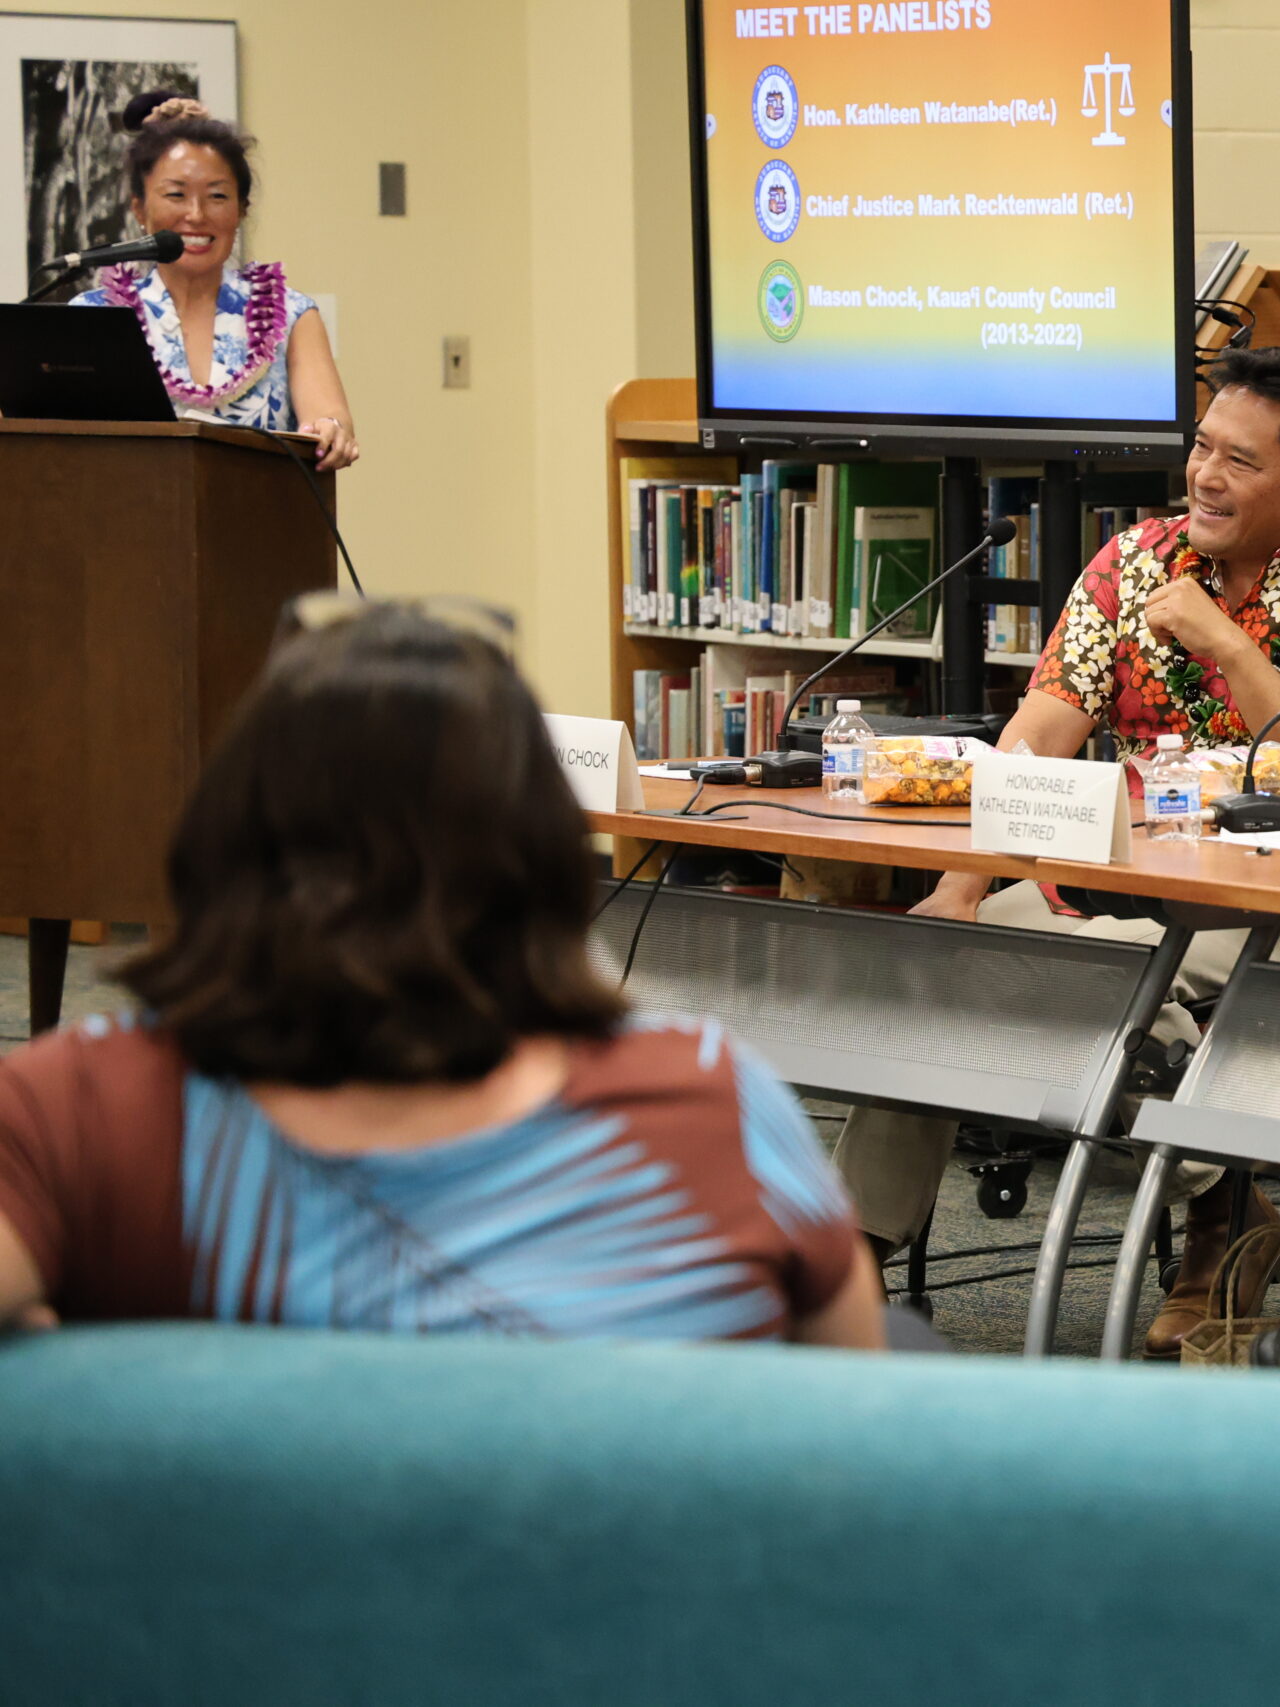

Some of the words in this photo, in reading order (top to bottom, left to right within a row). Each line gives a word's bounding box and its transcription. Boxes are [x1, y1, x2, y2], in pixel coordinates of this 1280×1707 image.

[736, 7, 798, 38] MEET
[804, 5, 852, 35] THE
[858, 0, 992, 33] PANELISTS
[803, 105, 841, 126] Hon.
[845, 103, 920, 126] Kathleen
[924, 98, 1057, 127] Watanabe(Ret.)
[806, 195, 849, 217] Chief
[853, 195, 914, 216] Justice
[918, 194, 961, 216] Mark
[965, 192, 1079, 216] Recktenwald
[1085, 191, 1134, 220] (Ret.)
[808, 285, 862, 307] Mason
[866, 285, 923, 312] Chock,
[985, 286, 1045, 314] County
[1050, 286, 1116, 309] Council
[981, 322, 1083, 351] (2013-2022)
[568, 748, 609, 770] CHOCK
[1005, 774, 1076, 796] HONORABLE
[978, 796, 1031, 816] KATHLEEN
[1033, 800, 1100, 826] WATANABE,
[1007, 821, 1056, 841] RETIRED
